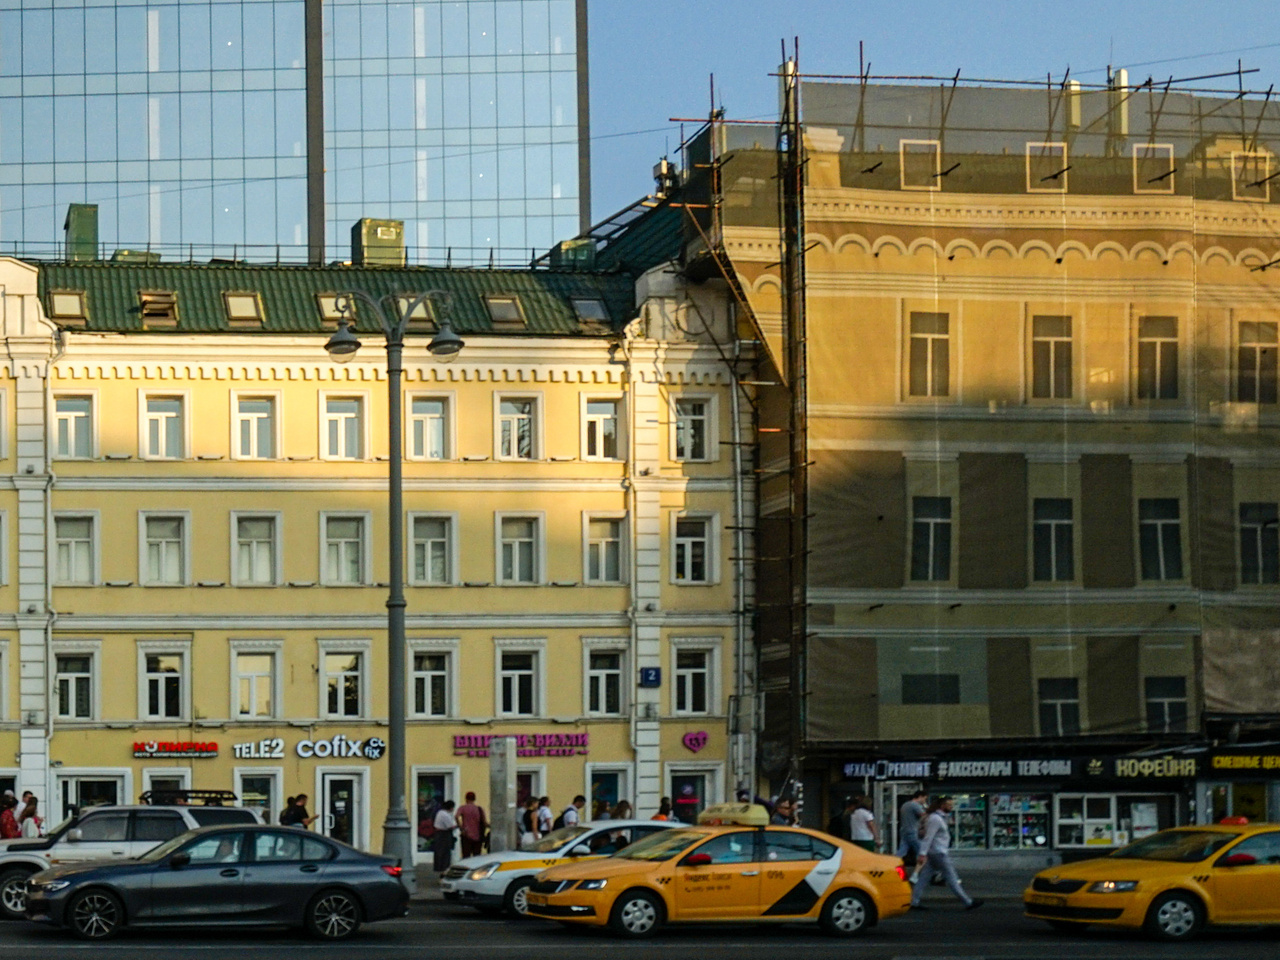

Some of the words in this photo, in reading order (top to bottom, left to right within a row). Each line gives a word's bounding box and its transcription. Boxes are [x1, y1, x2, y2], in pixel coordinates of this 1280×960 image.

[648, 670, 656, 680] 2
[233, 738, 285, 758] TELE2
[296, 734, 363, 758] cofix
[1017, 759, 1072, 776] ТЕЛЕФОНЫ
[1116, 755, 1196, 777] КОФЕЙНЯ
